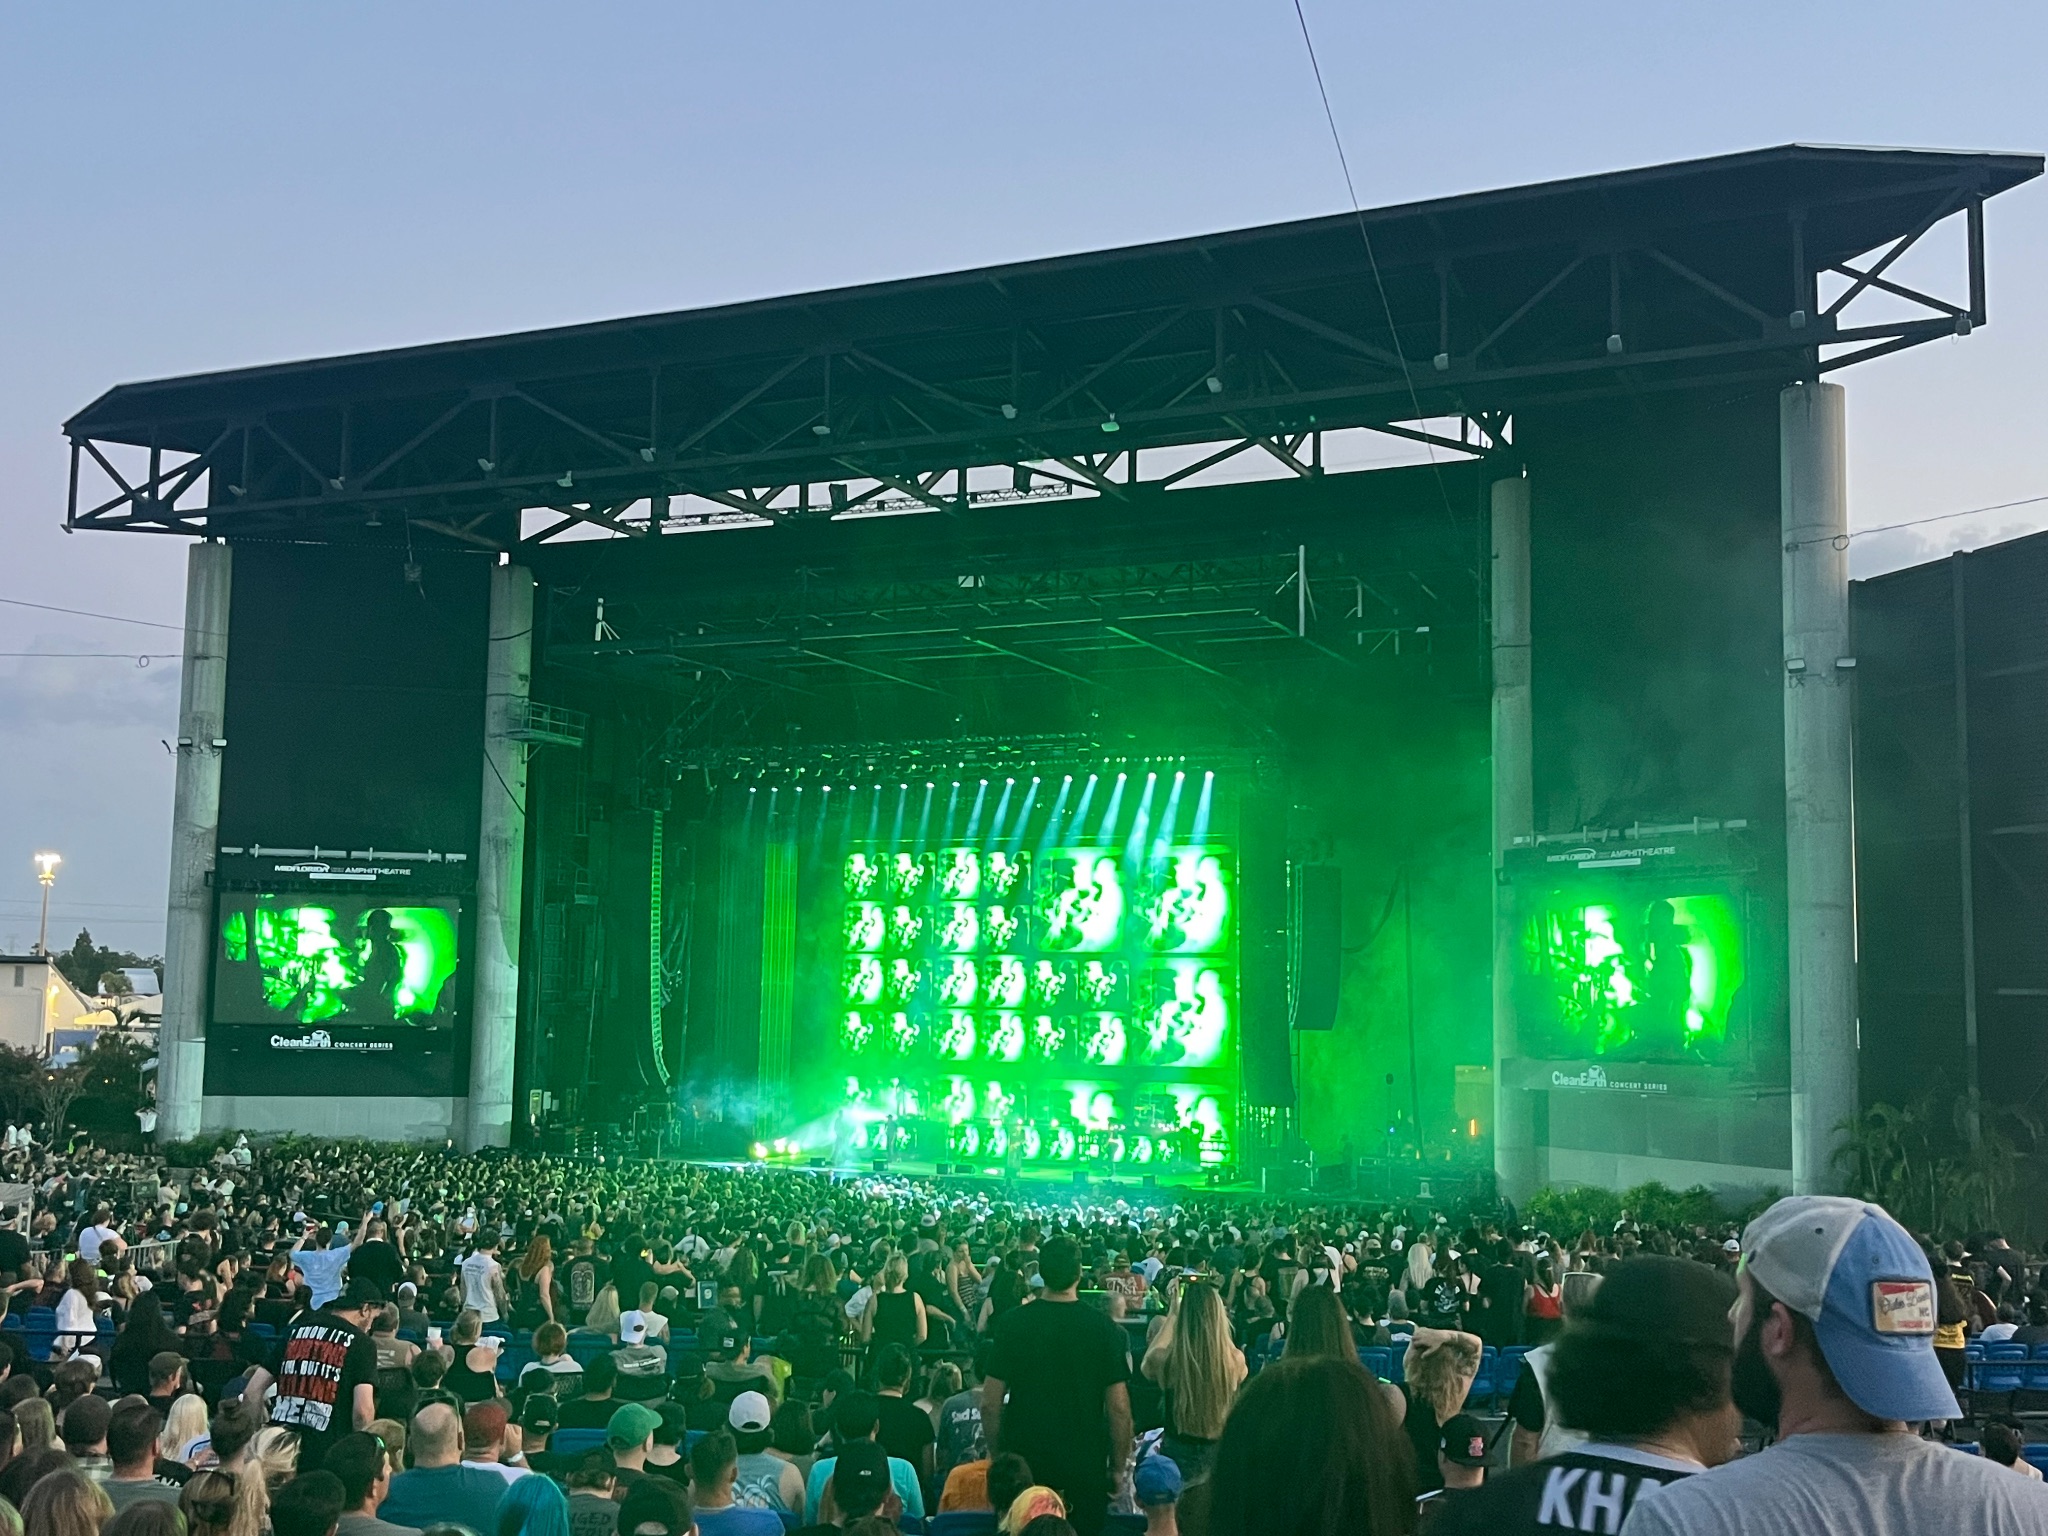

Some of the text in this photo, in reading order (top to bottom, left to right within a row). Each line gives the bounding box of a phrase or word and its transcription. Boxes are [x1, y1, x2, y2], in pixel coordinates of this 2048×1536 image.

[1610, 847, 1676, 858] AMPHITHEATRE
[274, 864, 330, 873] MIDFLORIDA
[344, 867, 411, 876] AMPHITHEATRE
[271, 1031, 331, 1048] CleanEarth
[1552, 1067, 1668, 1091] CleanEarth CONCERT SERIES
[296, 1325, 329, 1340] KNOW
[328, 1329, 355, 1347] IT'S
[300, 1360, 320, 1376] BUT
[320, 1363, 341, 1382] IT'S
[270, 1394, 306, 1424] ME
[1537, 1466, 1662, 1536] KH
